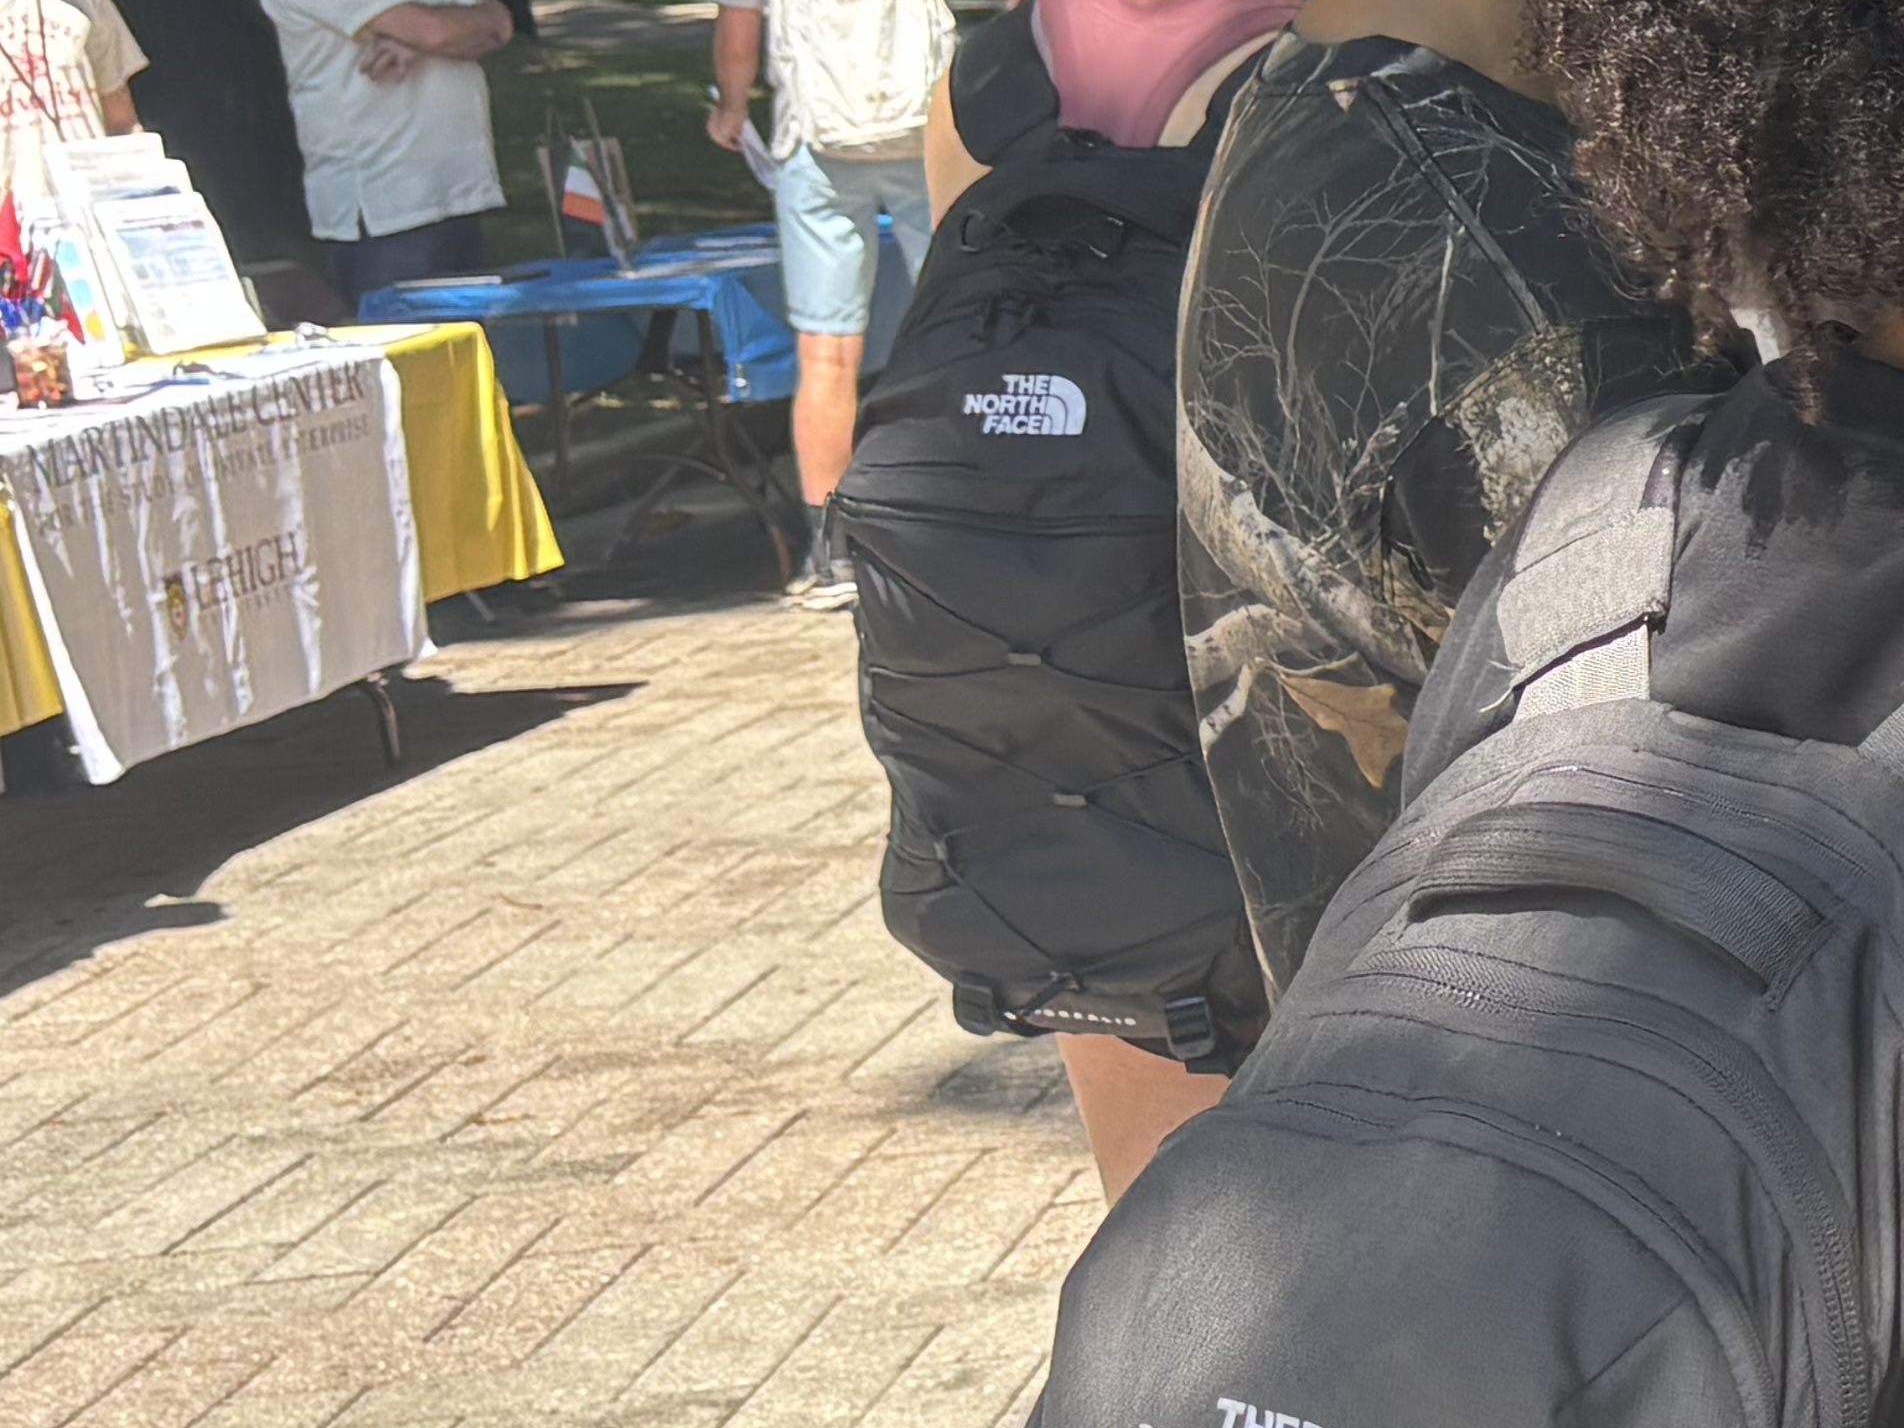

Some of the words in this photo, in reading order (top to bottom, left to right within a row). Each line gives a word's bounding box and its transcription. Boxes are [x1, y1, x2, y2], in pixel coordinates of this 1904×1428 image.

[1002, 374, 1051, 394] THE
[963, 394, 1046, 414] NORTH
[982, 415, 1044, 435] FACE
